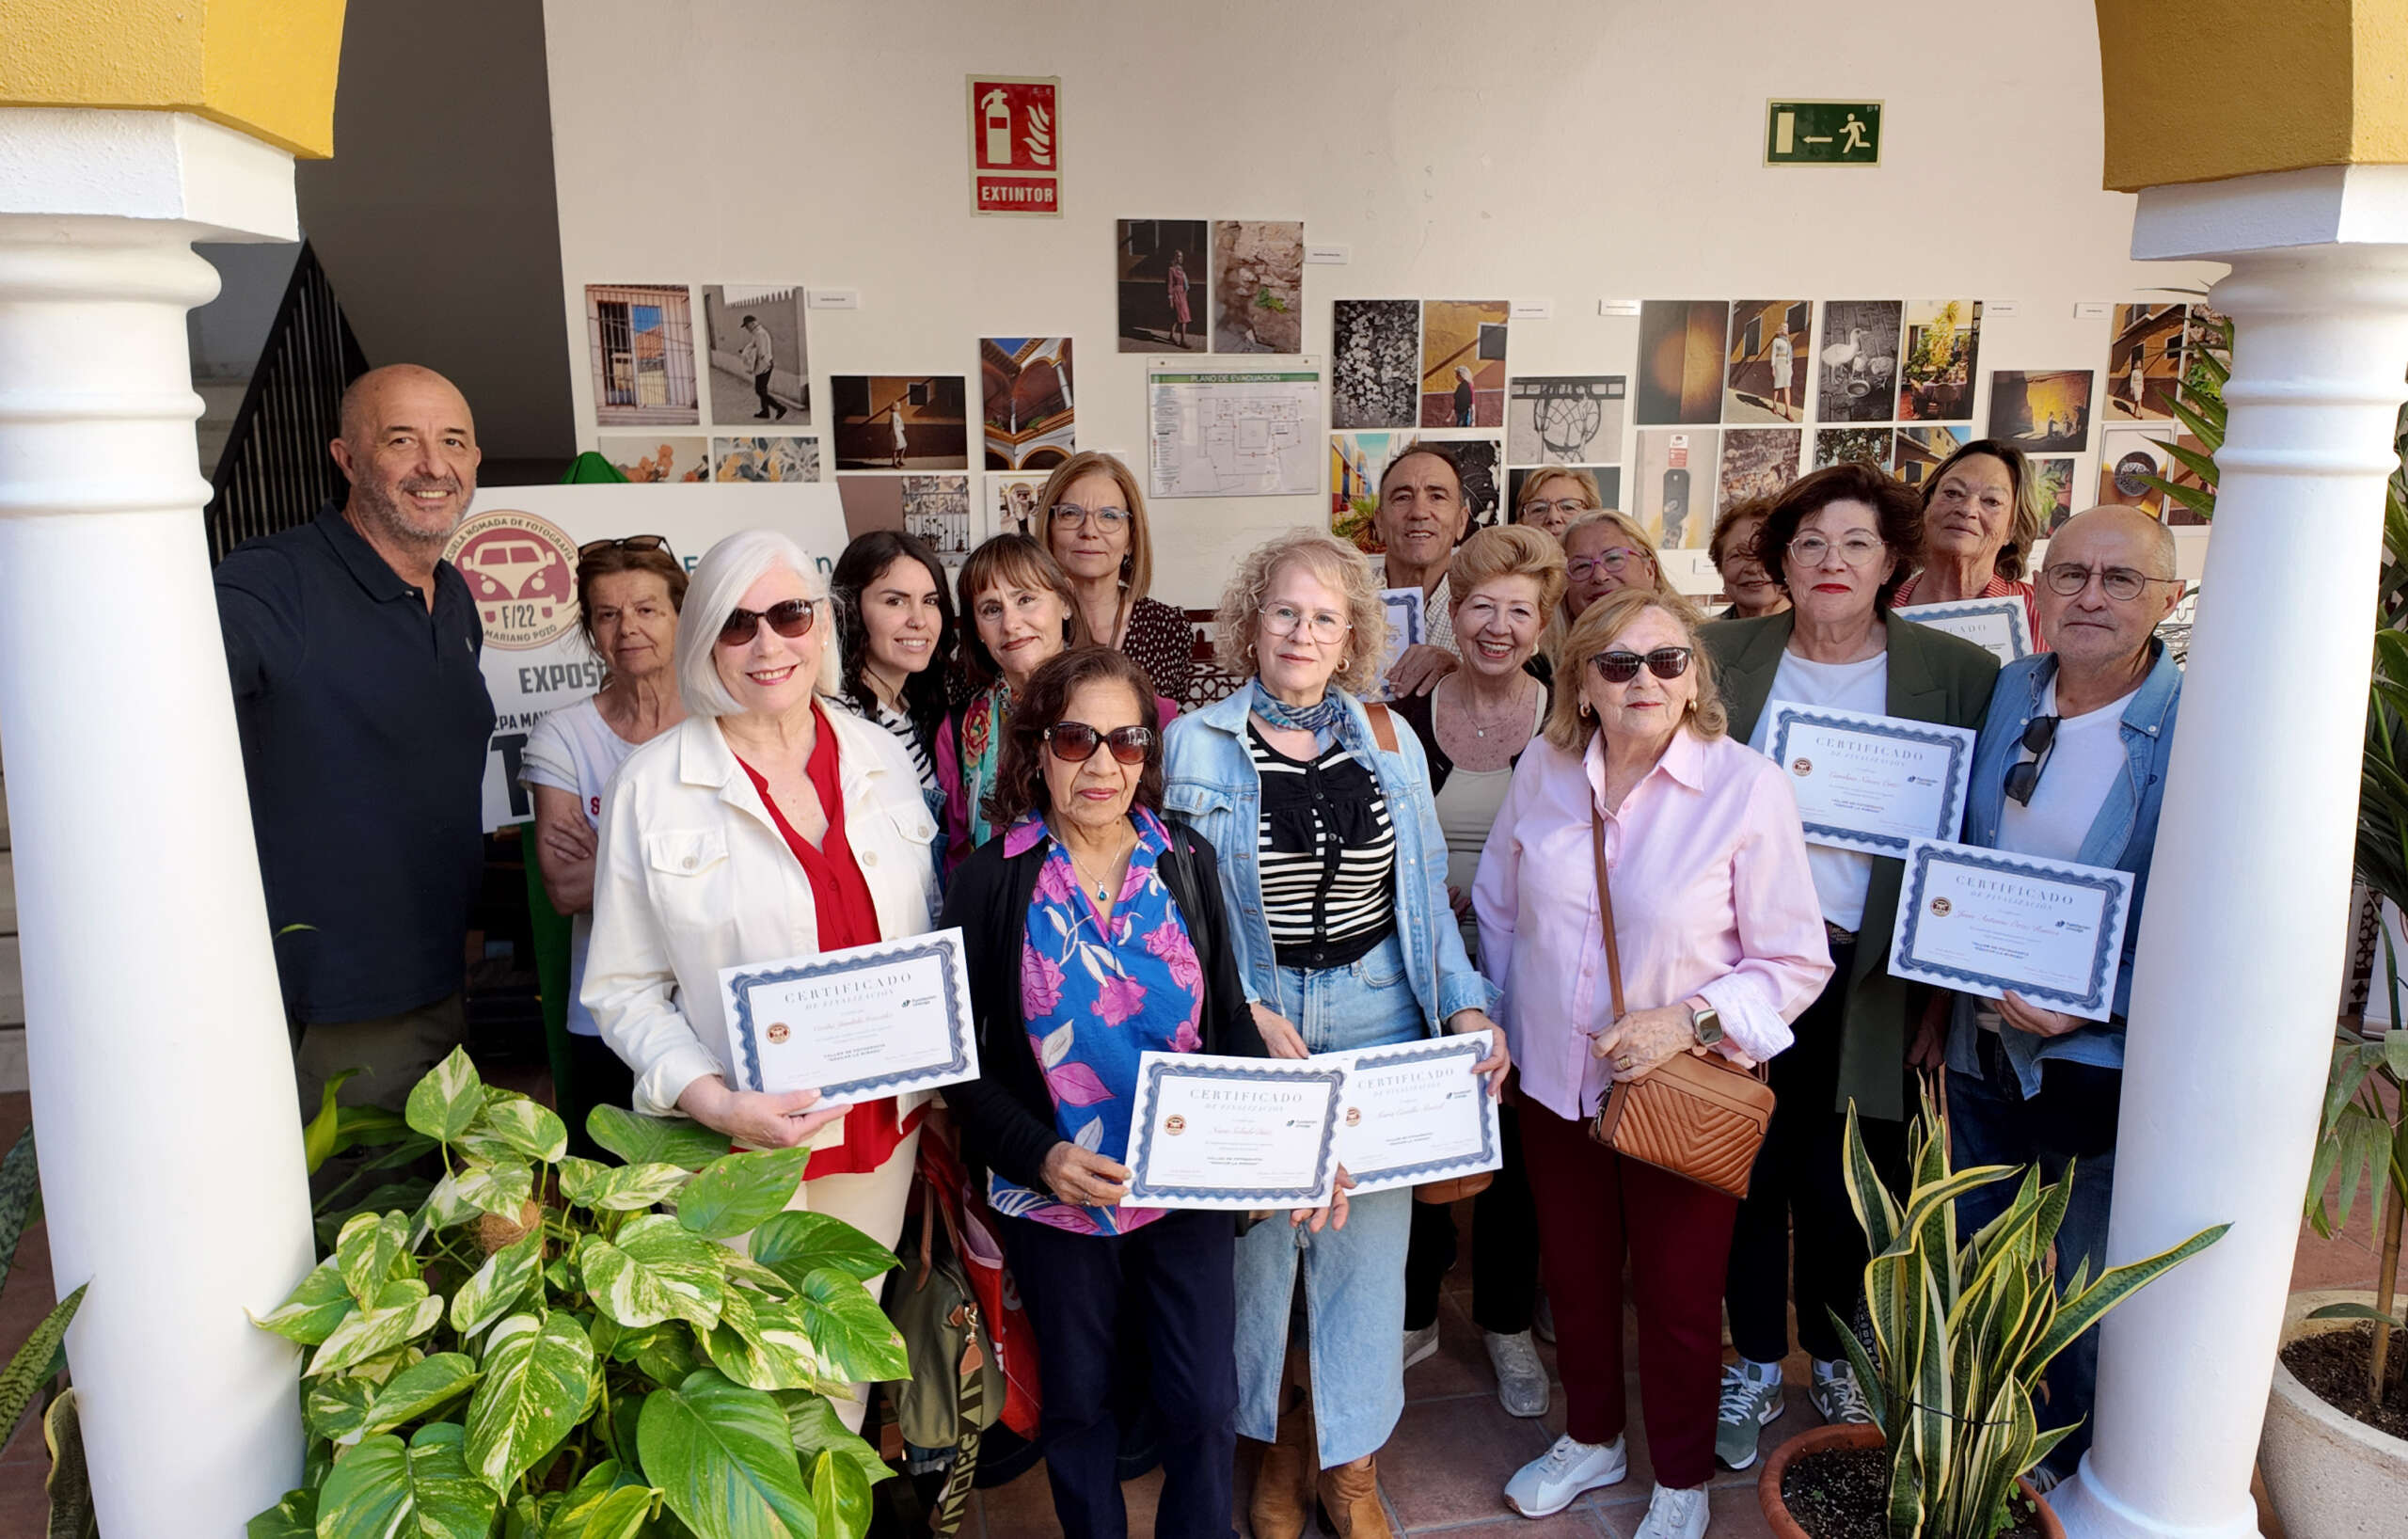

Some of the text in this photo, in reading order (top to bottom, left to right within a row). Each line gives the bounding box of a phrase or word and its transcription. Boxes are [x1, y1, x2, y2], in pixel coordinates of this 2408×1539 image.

[981, 185, 1054, 203] EXTINTOR
[1190, 375, 1217, 384] PLANO
[445, 534, 467, 560] CUELA
[510, 518, 524, 527] DE
[501, 604, 537, 629] F/22
[483, 625, 558, 643] MARIANO POZO
[519, 660, 606, 694] EXPOSI
[1815, 737, 1923, 761] CERTIFICADO
[1956, 875, 2074, 905] CERTIFICADO
[784, 973, 911, 1003] CERTIFICADO
[1357, 1068, 1454, 1089] CERTIFICADO
[1190, 1089, 1302, 1103] CERTIFICADO
